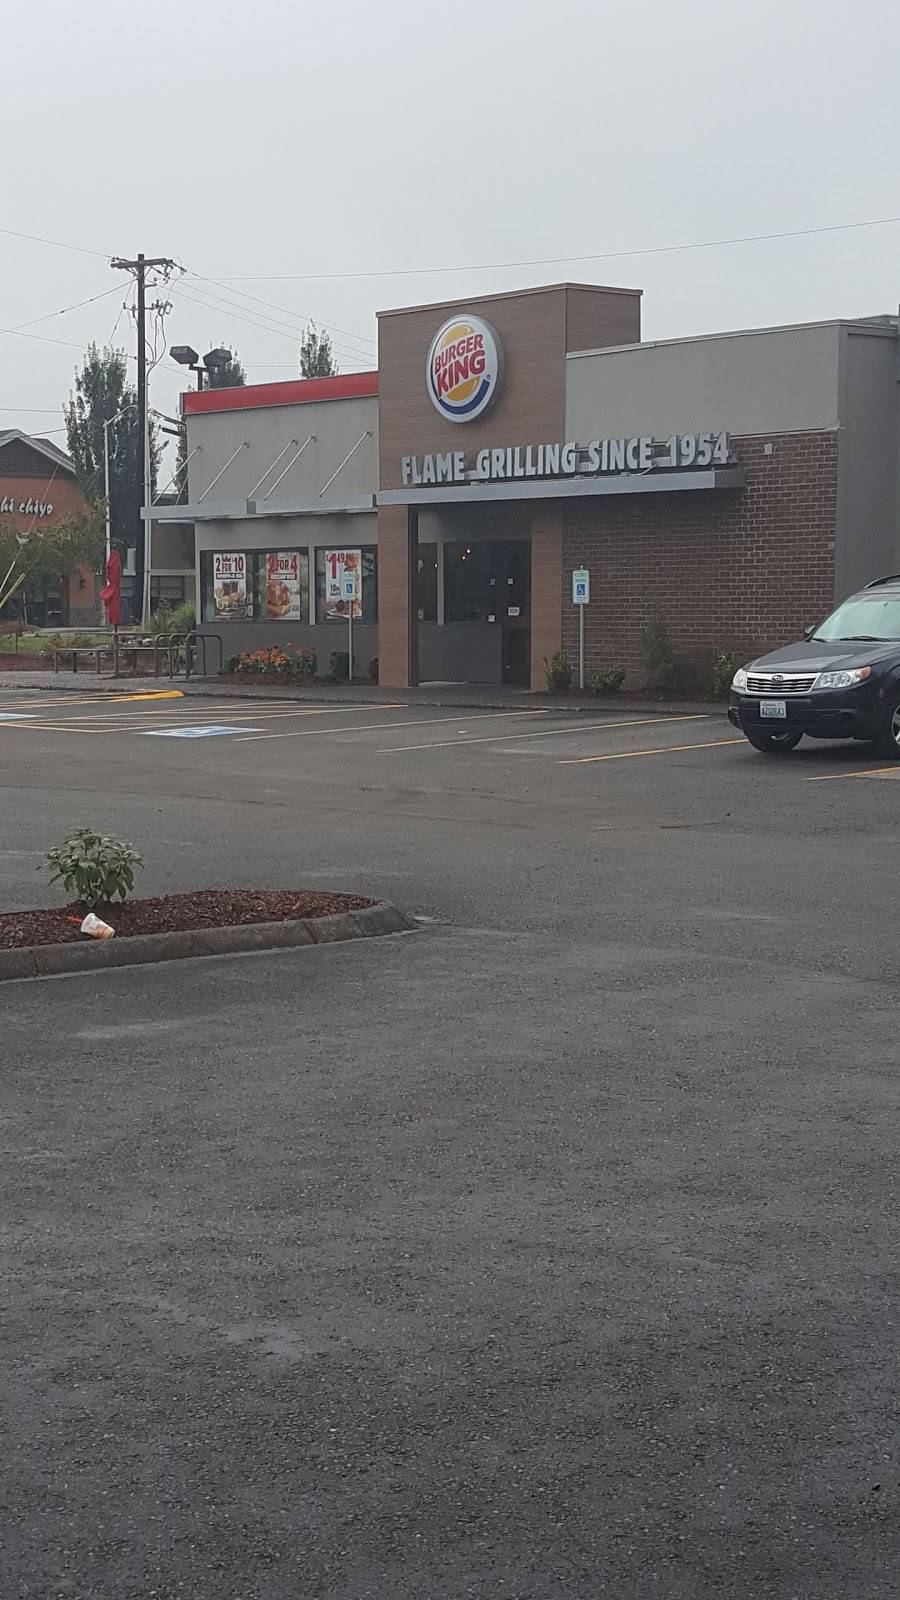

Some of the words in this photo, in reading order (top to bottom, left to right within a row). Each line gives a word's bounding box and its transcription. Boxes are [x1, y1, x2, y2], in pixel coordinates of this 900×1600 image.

[434, 334, 484, 374] BURGER
[436, 349, 486, 399] KING
[401, 451, 465, 485] FLAME
[476, 442, 576, 479] GRILLING
[588, 436, 653, 472] SINCE
[665, 431, 729, 467] 1954
[19, 497, 53, 518] chiyo
[215, 556, 221, 573] 2
[277, 559, 290, 571] FOR
